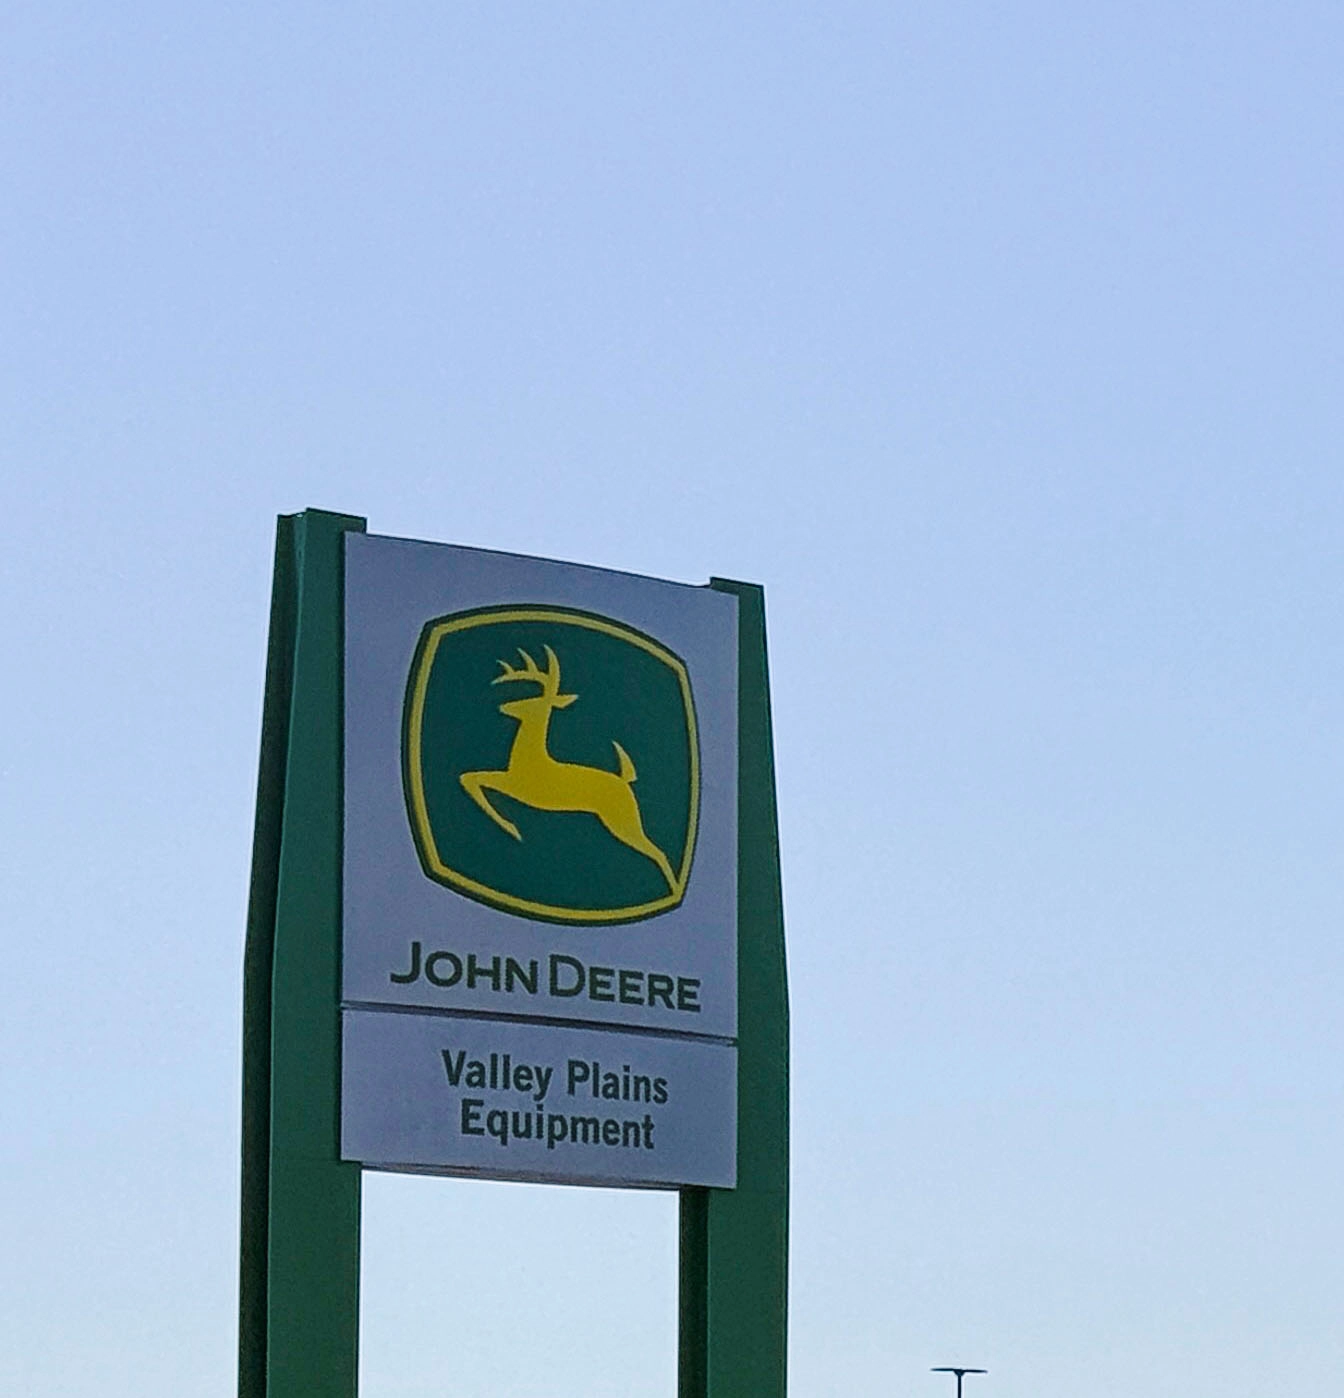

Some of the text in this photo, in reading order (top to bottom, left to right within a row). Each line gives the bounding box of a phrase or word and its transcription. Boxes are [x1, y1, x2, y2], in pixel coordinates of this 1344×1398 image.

[390, 941, 701, 1013] JOHN DEERE
[441, 1050, 668, 1104] Valley Plains
[461, 1099, 655, 1149] Equipment
